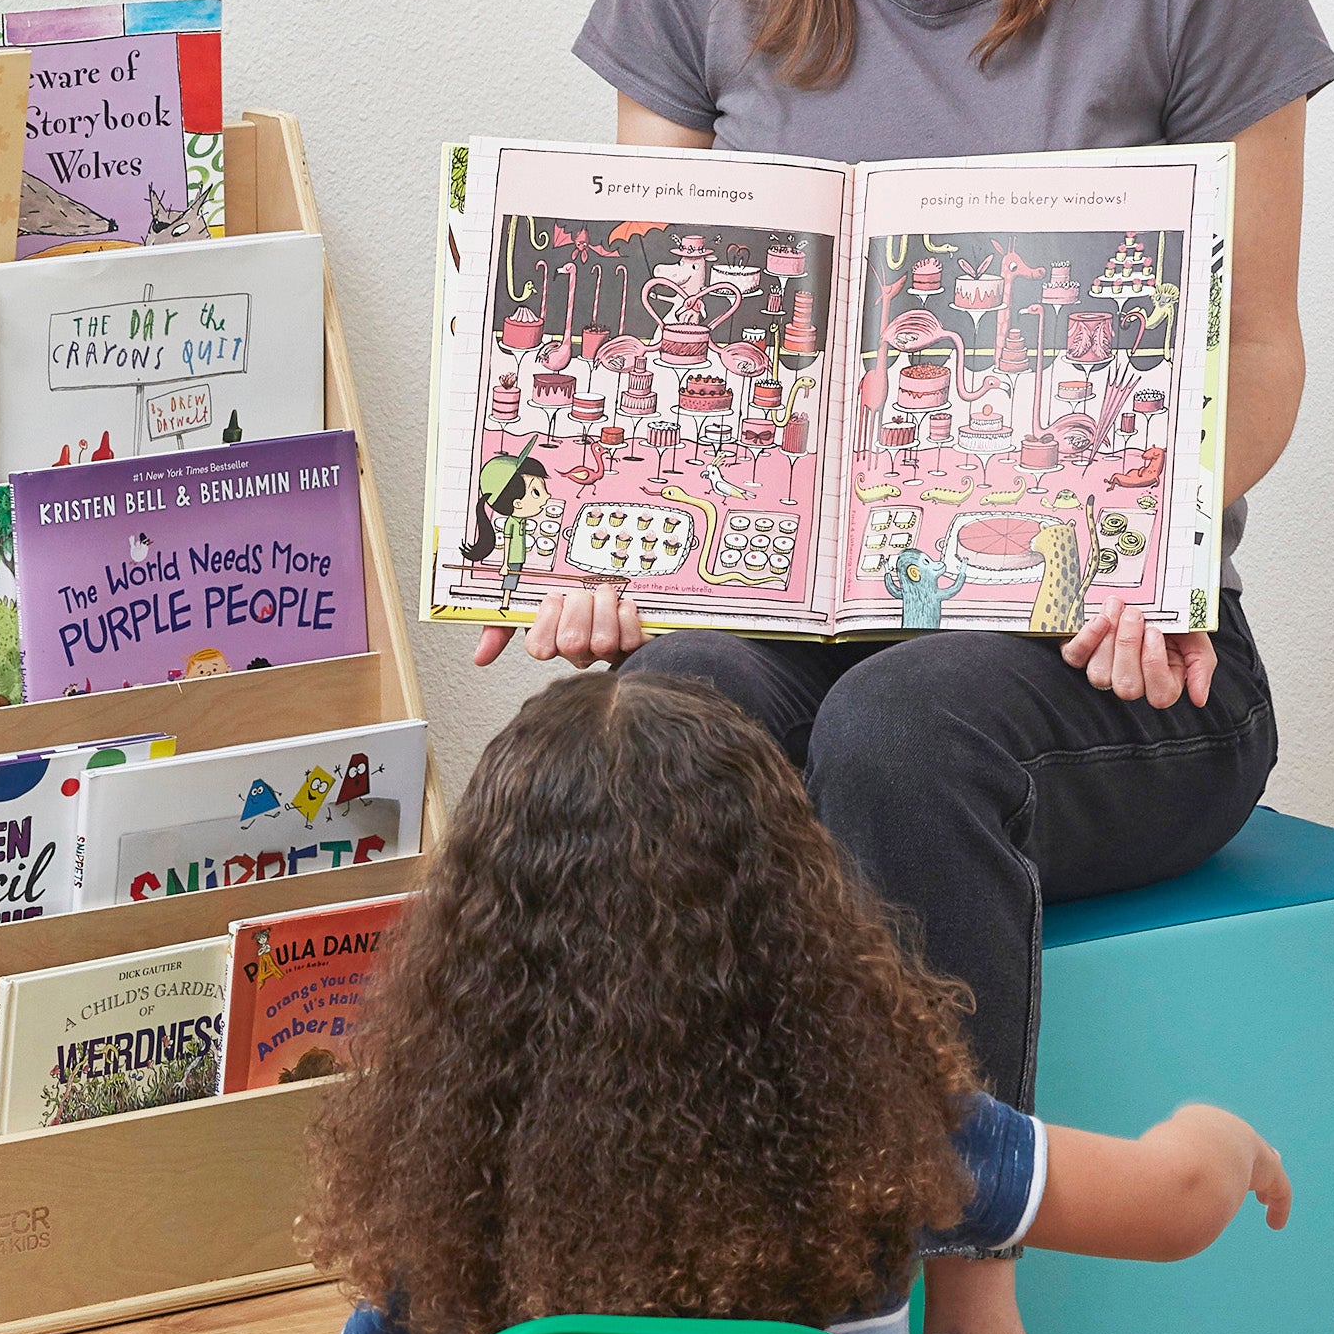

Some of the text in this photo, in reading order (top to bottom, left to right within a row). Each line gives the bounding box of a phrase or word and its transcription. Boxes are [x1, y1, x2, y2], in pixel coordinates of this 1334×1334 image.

[28, 50, 140, 89] eware of
[25, 95, 172, 140] Storybook
[46, 149, 142, 184] Wolves
[592, 175, 754, 203] 5 pretty pink flamingos
[921, 191, 1127, 209] posing in the bakery windows!
[73, 303, 225, 340] THE DAY the
[52, 336, 242, 374] CRAYONS QUIT
[170, 394, 206, 412] DREW
[133, 459, 249, 482] #1 New York Times Bestseller
[39, 465, 340, 525] KRISTEN BELL & BENJAMIN HART
[58, 540, 331, 615] The World Needs More
[633, 581, 649, 590] Spot
[651, 582, 663, 590] the
[664, 584, 679, 592] pink
[59, 583, 337, 667] PURPLE PEOPLE
[118, 961, 182, 981] DICK GAUTIER
[243, 938, 316, 990] PAULA
[323, 931, 381, 957] DANZ
[65, 1017, 77, 1032] A
[81, 985, 150, 1020] CHILD'S
[139, 1004, 155, 1017] OF
[266, 982, 317, 1018] Orange
[320, 975, 345, 988] You
[303, 997, 325, 1014] It's
[257, 1017, 327, 1062] Amber
